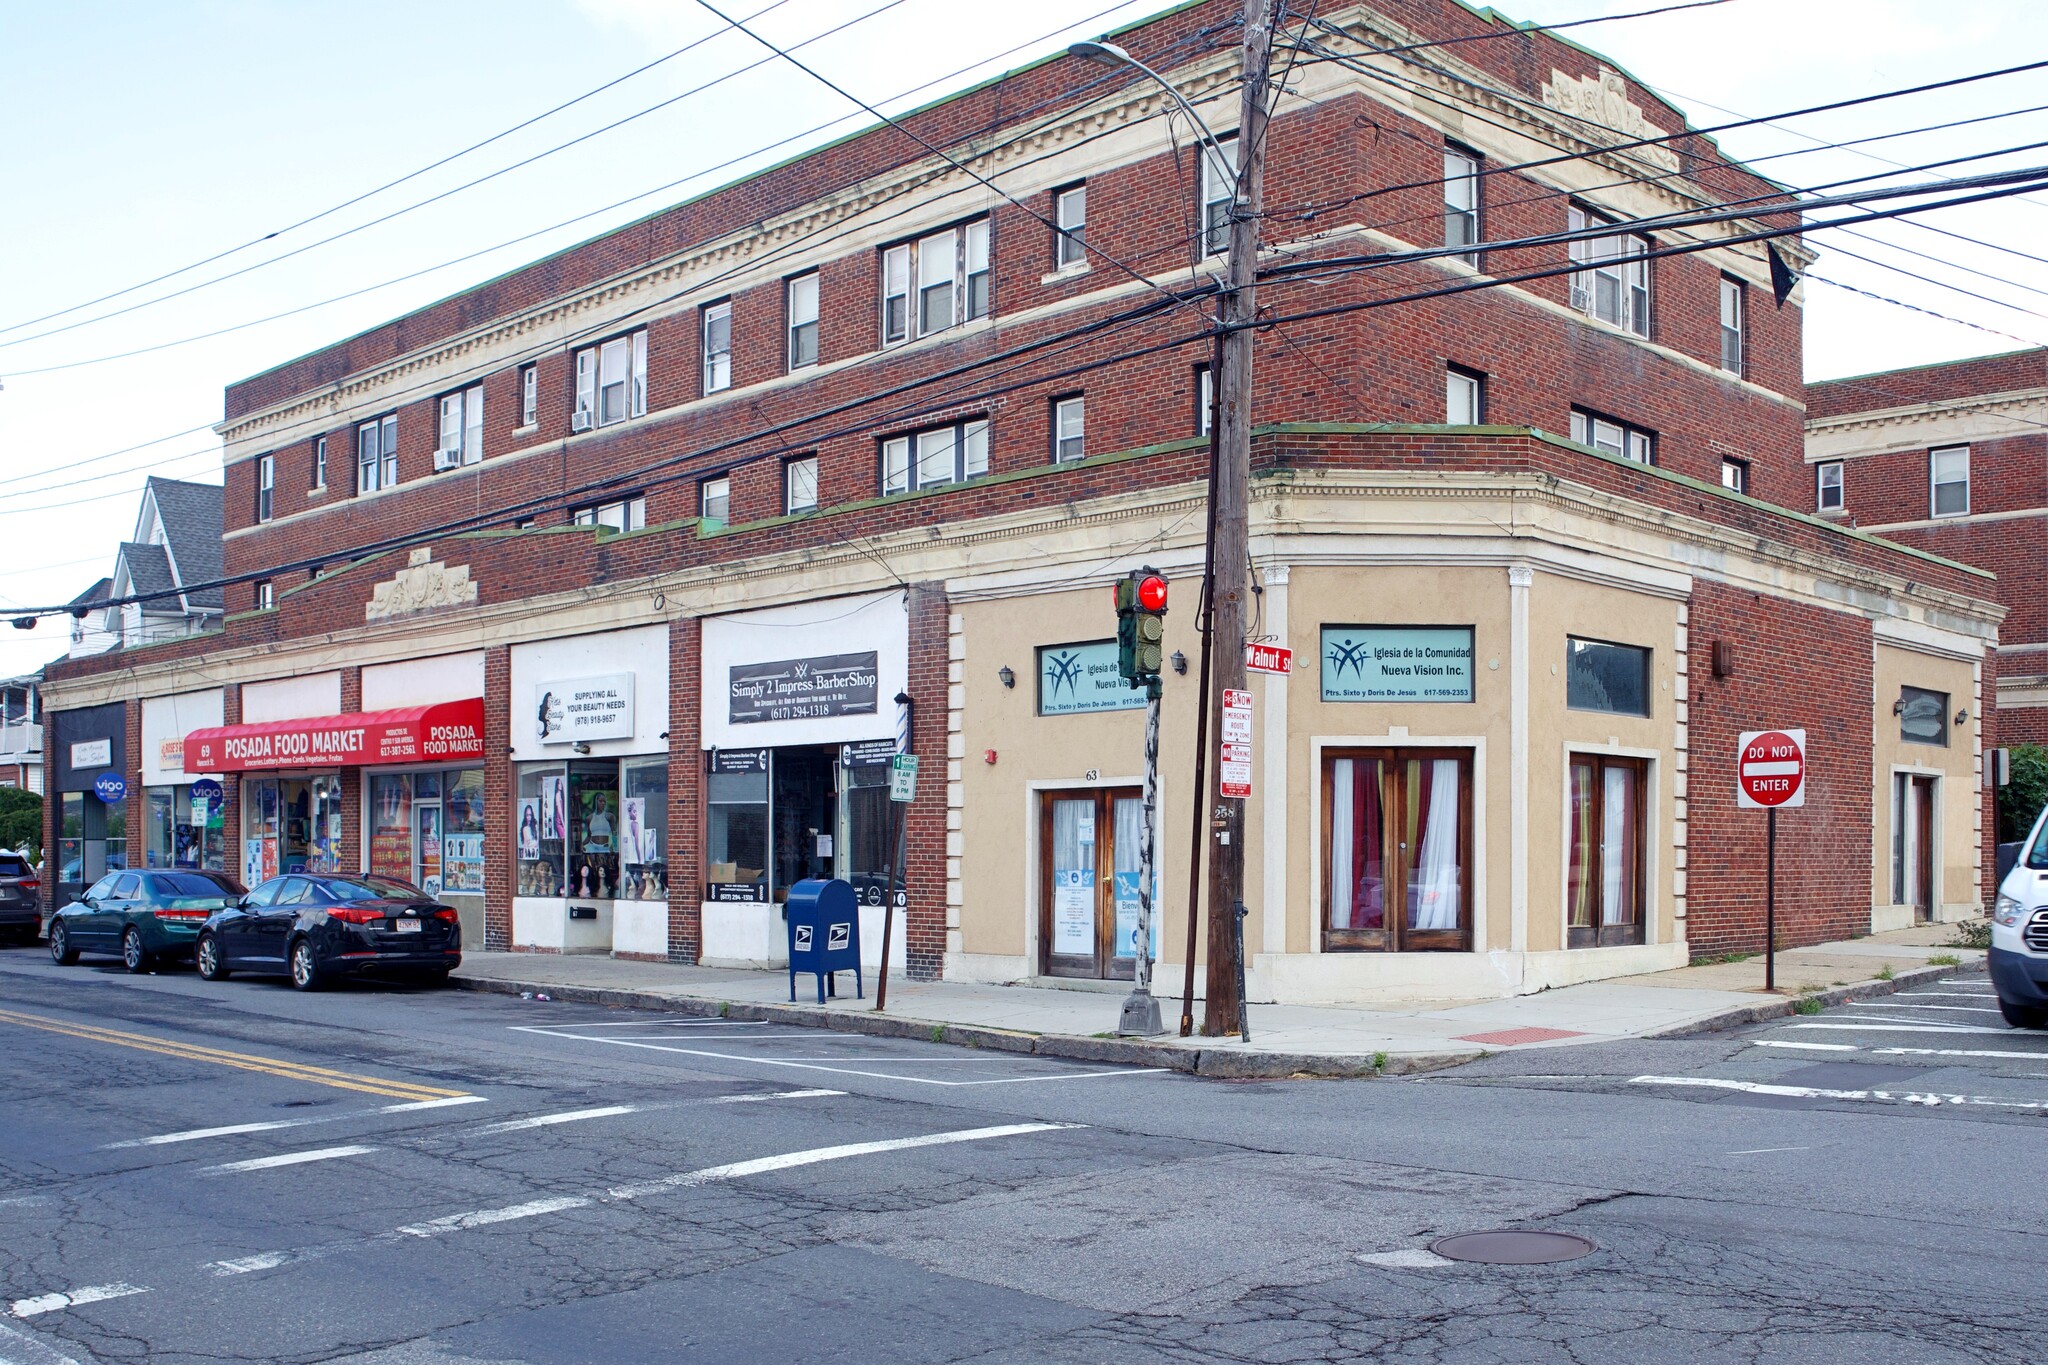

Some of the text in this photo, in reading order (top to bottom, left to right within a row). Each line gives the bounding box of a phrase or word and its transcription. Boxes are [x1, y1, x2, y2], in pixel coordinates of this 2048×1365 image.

[1247, 646, 1279, 669] Walnut
[1374, 647, 1471, 660] Iglesia de la Comunidad
[1087, 664, 1109, 677] Iglesia
[1109, 663, 1118, 673] de
[1381, 665, 1464, 676] Nueva Vision Inc.
[731, 671, 876, 699] Simply 2 Impress BarberShop
[1095, 678, 1131, 690] Nueva Visi
[574, 689, 618, 701] SUPPLYING ALL
[1325, 689, 1342, 697] Ptrs.
[1343, 689, 1361, 697] Sixto
[1362, 690, 1367, 698] y
[1367, 689, 1385, 697] Doris
[1387, 689, 1396, 697] De
[1424, 689, 1469, 697] 617-569-2353
[567, 700, 626, 713] YOUR BEAUTY NEEDS
[1232, 695, 1251, 706] SNOW
[770, 704, 830, 721] (617) 294-1318
[1044, 704, 1057, 712] Ptrs.
[574, 713, 617, 728] (978) 918-9657
[1225, 711, 1250, 721] EMERGENCY
[402, 727, 408, 735] DE
[1231, 721, 1245, 730] ROUTE
[430, 725, 476, 740] POSADA
[225, 728, 366, 759] POSADA FOOD MARKET
[400, 735, 414, 744] AMERICA
[201, 745, 210, 757] 69
[380, 744, 416, 757] 617-387-2561
[423, 738, 484, 754] FOOD MARKET
[1749, 745, 1795, 759] DO NOT
[328, 754, 344, 763] Frutas
[1223, 747, 1250, 758] NO PARKING
[895, 757, 900, 768] 1
[1085, 769, 1098, 781] 63
[96, 779, 124, 793] vigo
[1752, 779, 1789, 792] ENTER
[192, 785, 221, 799] vigo
[1215, 807, 1235, 819] 258
[720, 893, 732, 901] (617)
[731, 893, 741, 901] 294
